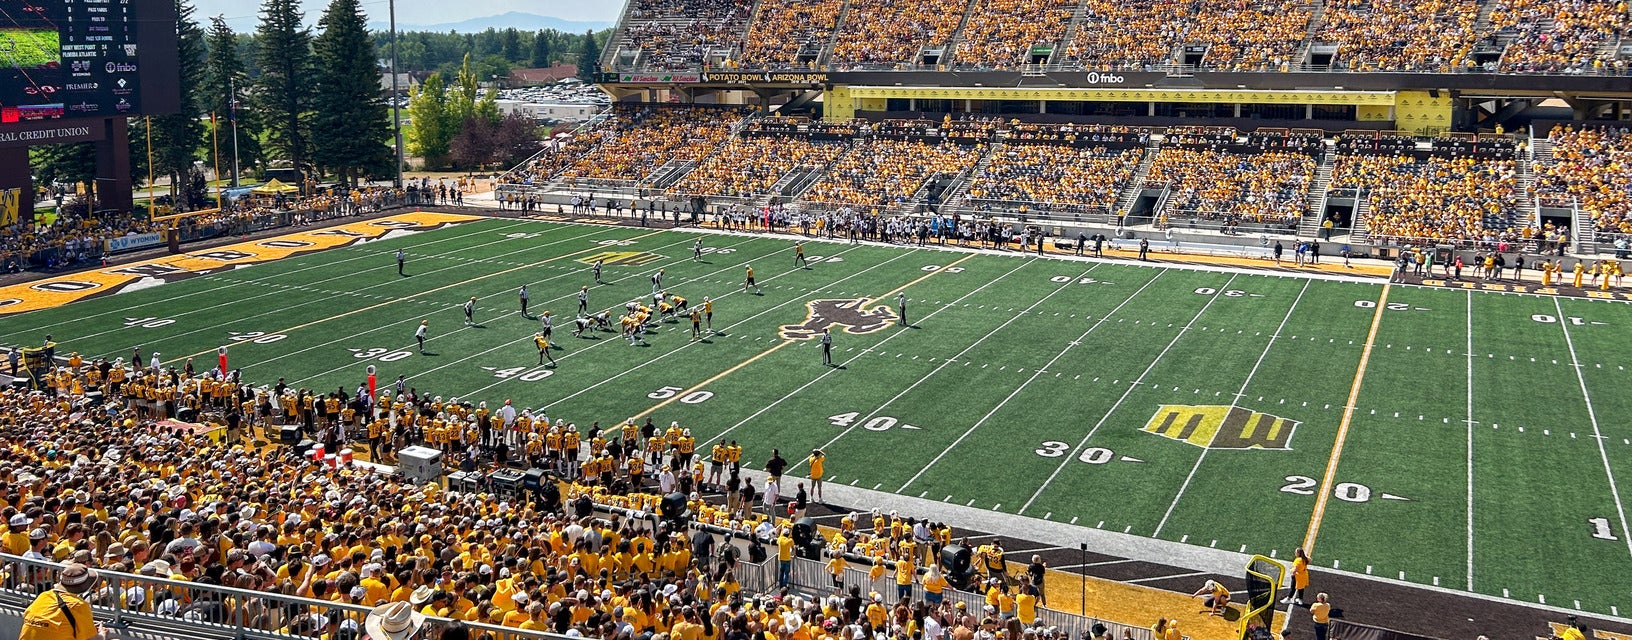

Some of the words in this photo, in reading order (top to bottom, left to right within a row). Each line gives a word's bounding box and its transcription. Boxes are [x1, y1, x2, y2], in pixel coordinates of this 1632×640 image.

[116, 62, 137, 72] fnbo
[709, 73, 740, 81] POTATO
[741, 73, 764, 81] BOWL
[772, 73, 805, 81] ARIZONA
[806, 73, 829, 81] BOWL
[1100, 73, 1125, 84] fnbo
[19, 129, 56, 140] CREDIT
[57, 126, 90, 137] UNION
[130, 234, 160, 244] WYOMING
[123, 316, 177, 329] 10
[228, 331, 289, 345] 20
[353, 346, 414, 363] 30
[493, 365, 556, 383] 40
[647, 385, 715, 405] 50
[827, 411, 899, 432] 40
[1035, 440, 1117, 465] 30
[1279, 474, 1373, 503] 20
